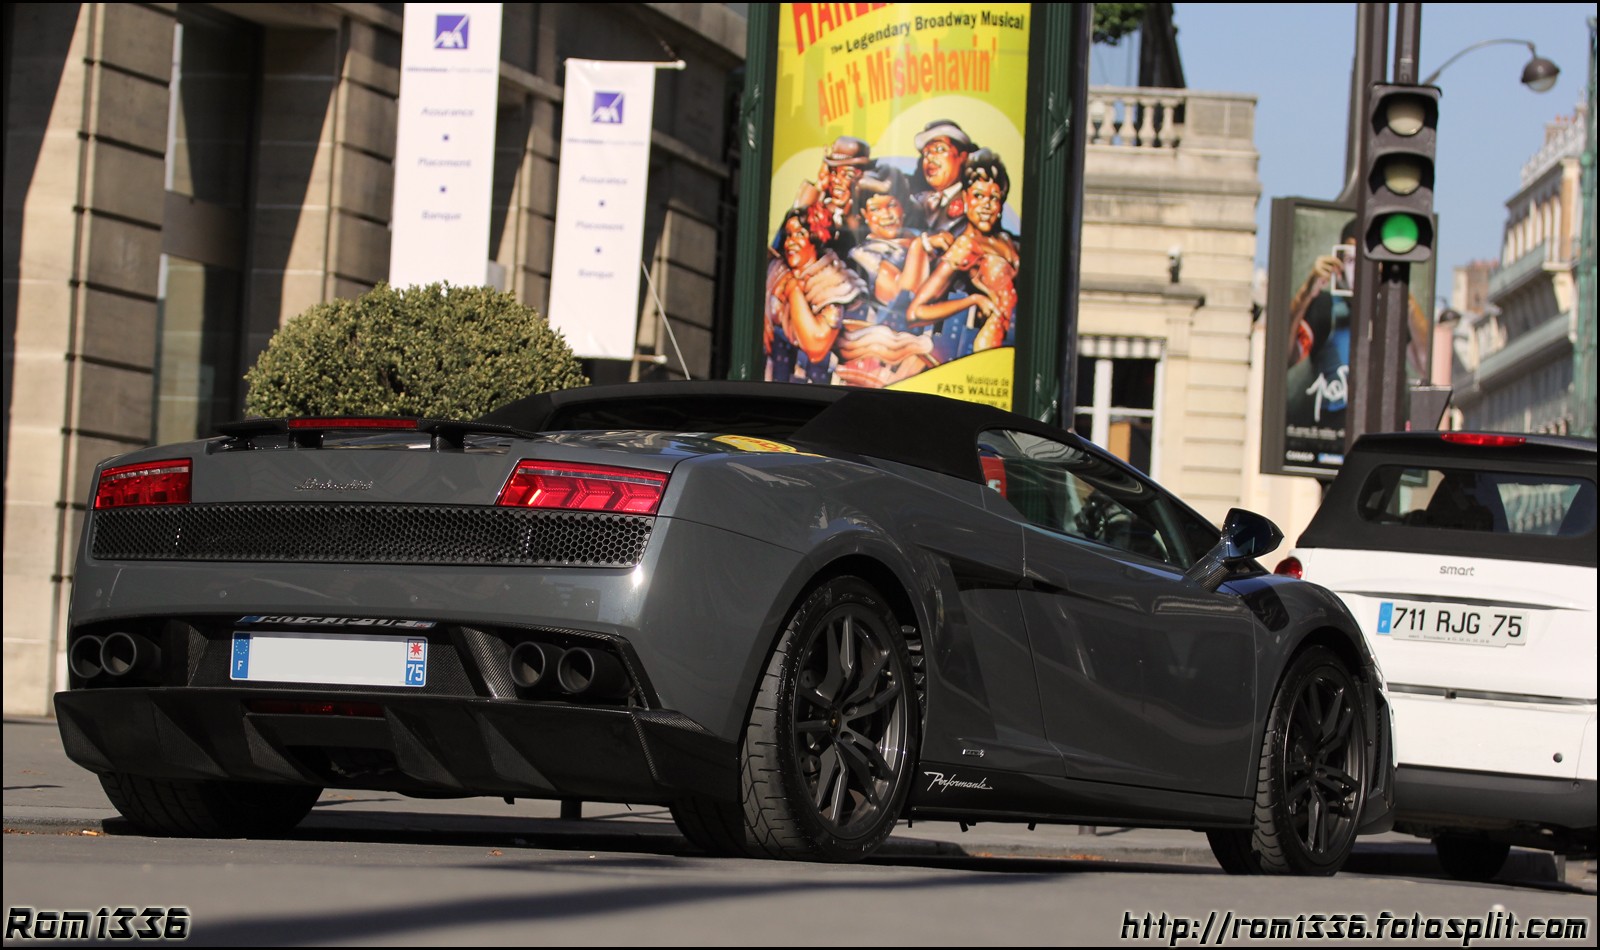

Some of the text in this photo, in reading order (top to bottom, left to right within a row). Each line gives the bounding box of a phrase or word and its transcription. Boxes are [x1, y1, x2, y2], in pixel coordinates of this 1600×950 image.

[845, 21, 911, 53] Legendary
[915, 11, 977, 31] Broadway
[980, 10, 1024, 30] Musical
[817, 34, 997, 127] Ain't Misbehavin'
[966, 374, 1009, 386] Musique de
[937, 383, 1009, 397] FATS WALLER
[1439, 565, 1475, 576] smart
[1381, 620, 1387, 629] F
[1393, 607, 1522, 638] 711 RJG 75
[237, 660, 244, 671] F
[407, 663, 424, 682] 75
[923, 771, 993, 793] Performante
